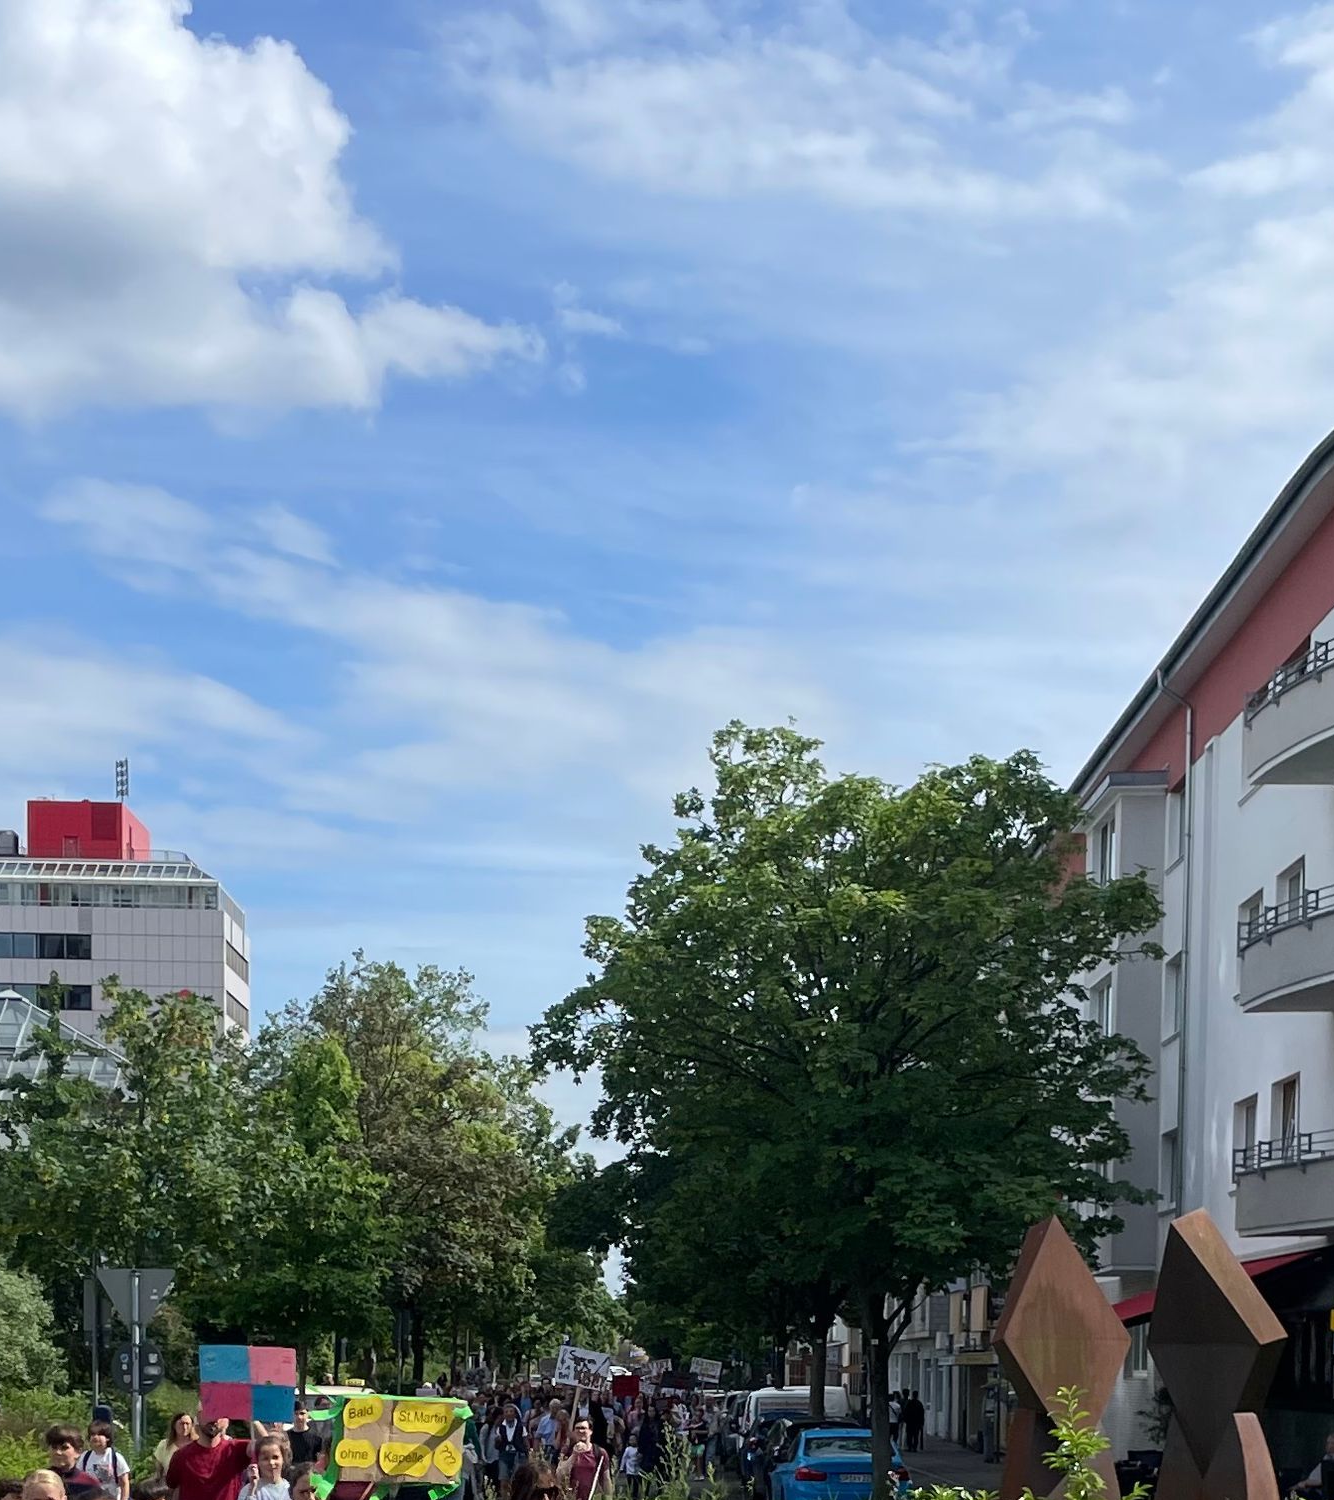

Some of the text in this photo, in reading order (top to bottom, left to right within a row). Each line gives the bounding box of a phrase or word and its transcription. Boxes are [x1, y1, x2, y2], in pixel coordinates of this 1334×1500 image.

[348, 1407, 374, 1419] Bald
[340, 1449, 369, 1460] ohne
[384, 1451, 424, 1464] Kapelle
